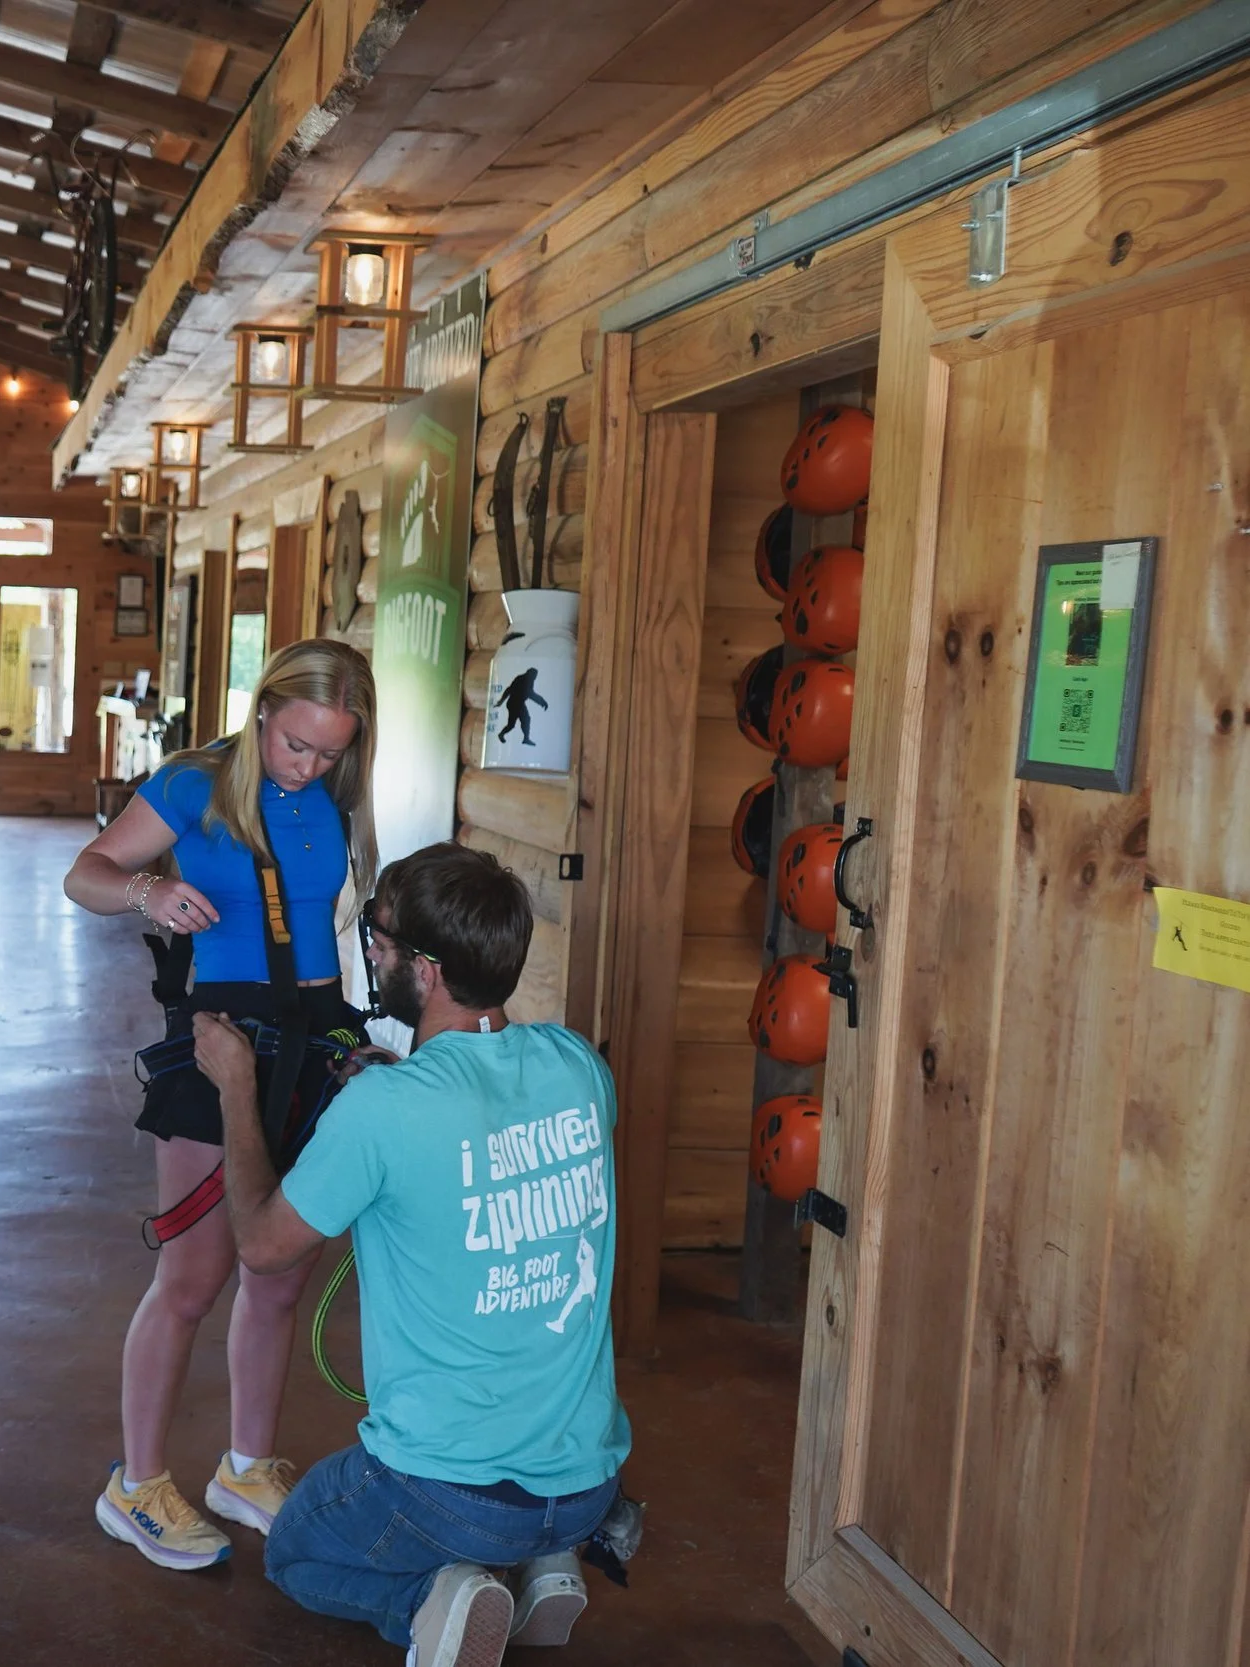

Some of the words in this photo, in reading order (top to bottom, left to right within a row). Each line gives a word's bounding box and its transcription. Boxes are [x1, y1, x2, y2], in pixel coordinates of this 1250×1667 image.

[383, 592, 446, 666] BIGFOOT
[461, 1139, 473, 1187] i
[487, 1102, 601, 1181] survived
[487, 1263, 519, 1290] BIG
[524, 1251, 562, 1284] FOOT
[474, 1273, 571, 1315] ADVENTURE
[130, 1506, 163, 1539] HOKA
